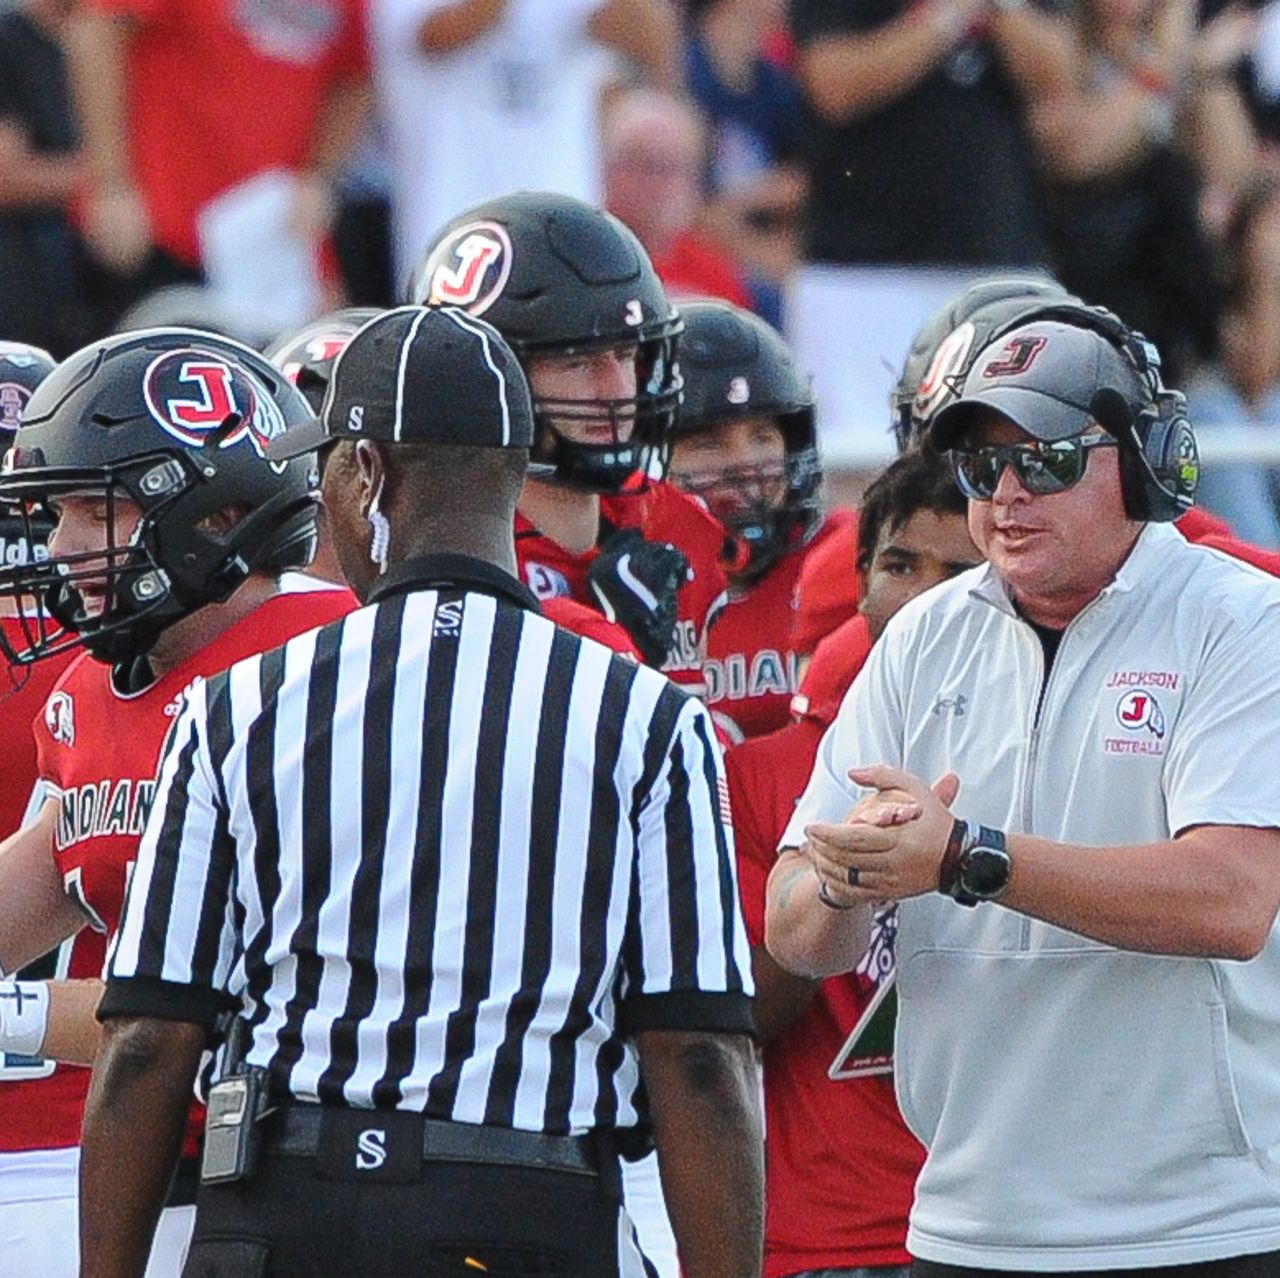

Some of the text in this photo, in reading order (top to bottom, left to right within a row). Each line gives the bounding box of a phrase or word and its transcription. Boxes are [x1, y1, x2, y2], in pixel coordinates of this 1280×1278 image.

[981, 336, 1047, 378] J
[166, 361, 236, 429] J
[348, 405, 364, 430] S
[435, 599, 462, 628] S
[1106, 671, 1179, 690] JACKSON
[1122, 695, 1148, 721] J
[1105, 738, 1163, 756] FOOTBALL
[356, 1130, 386, 1169] S
